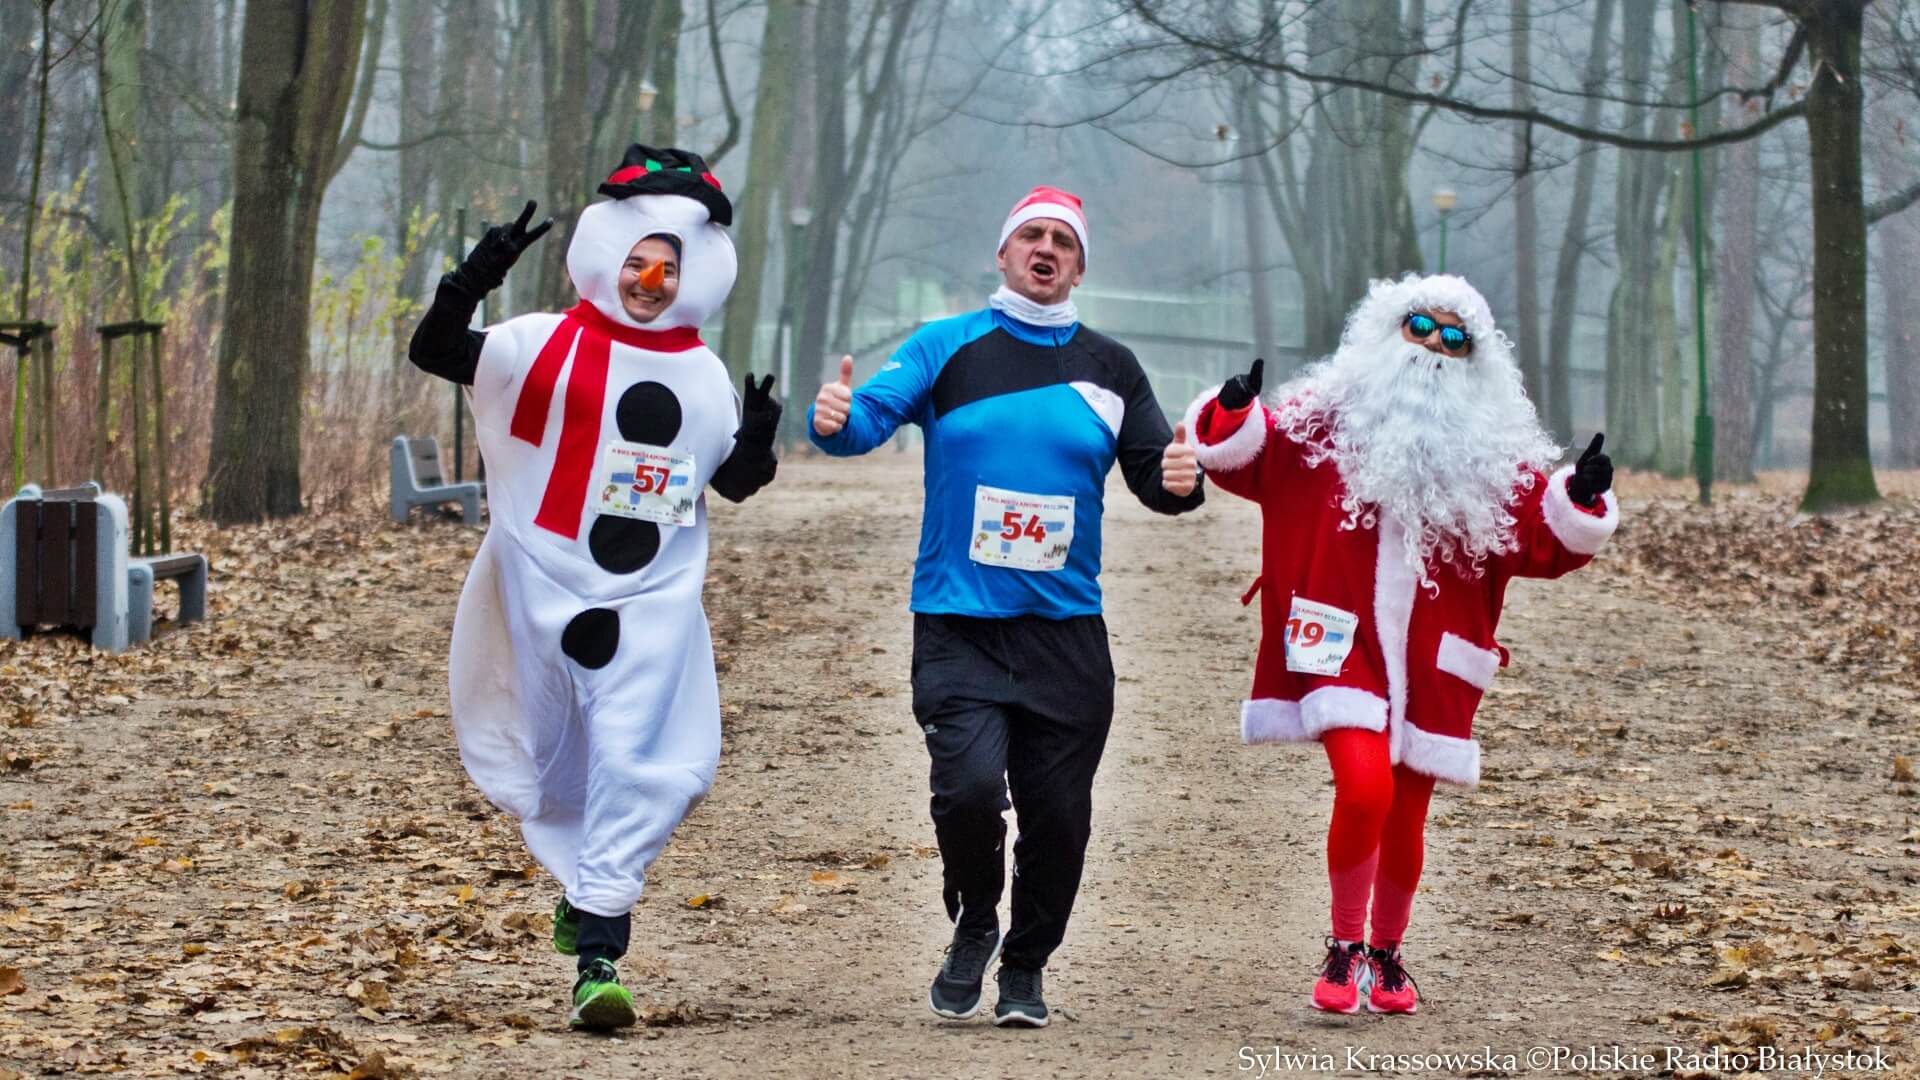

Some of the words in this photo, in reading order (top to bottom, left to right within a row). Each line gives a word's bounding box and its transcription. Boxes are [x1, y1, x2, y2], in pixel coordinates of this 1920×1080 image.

[632, 464, 671, 496] 57
[1000, 511, 1046, 544] 54
[1288, 618, 1325, 648] 19
